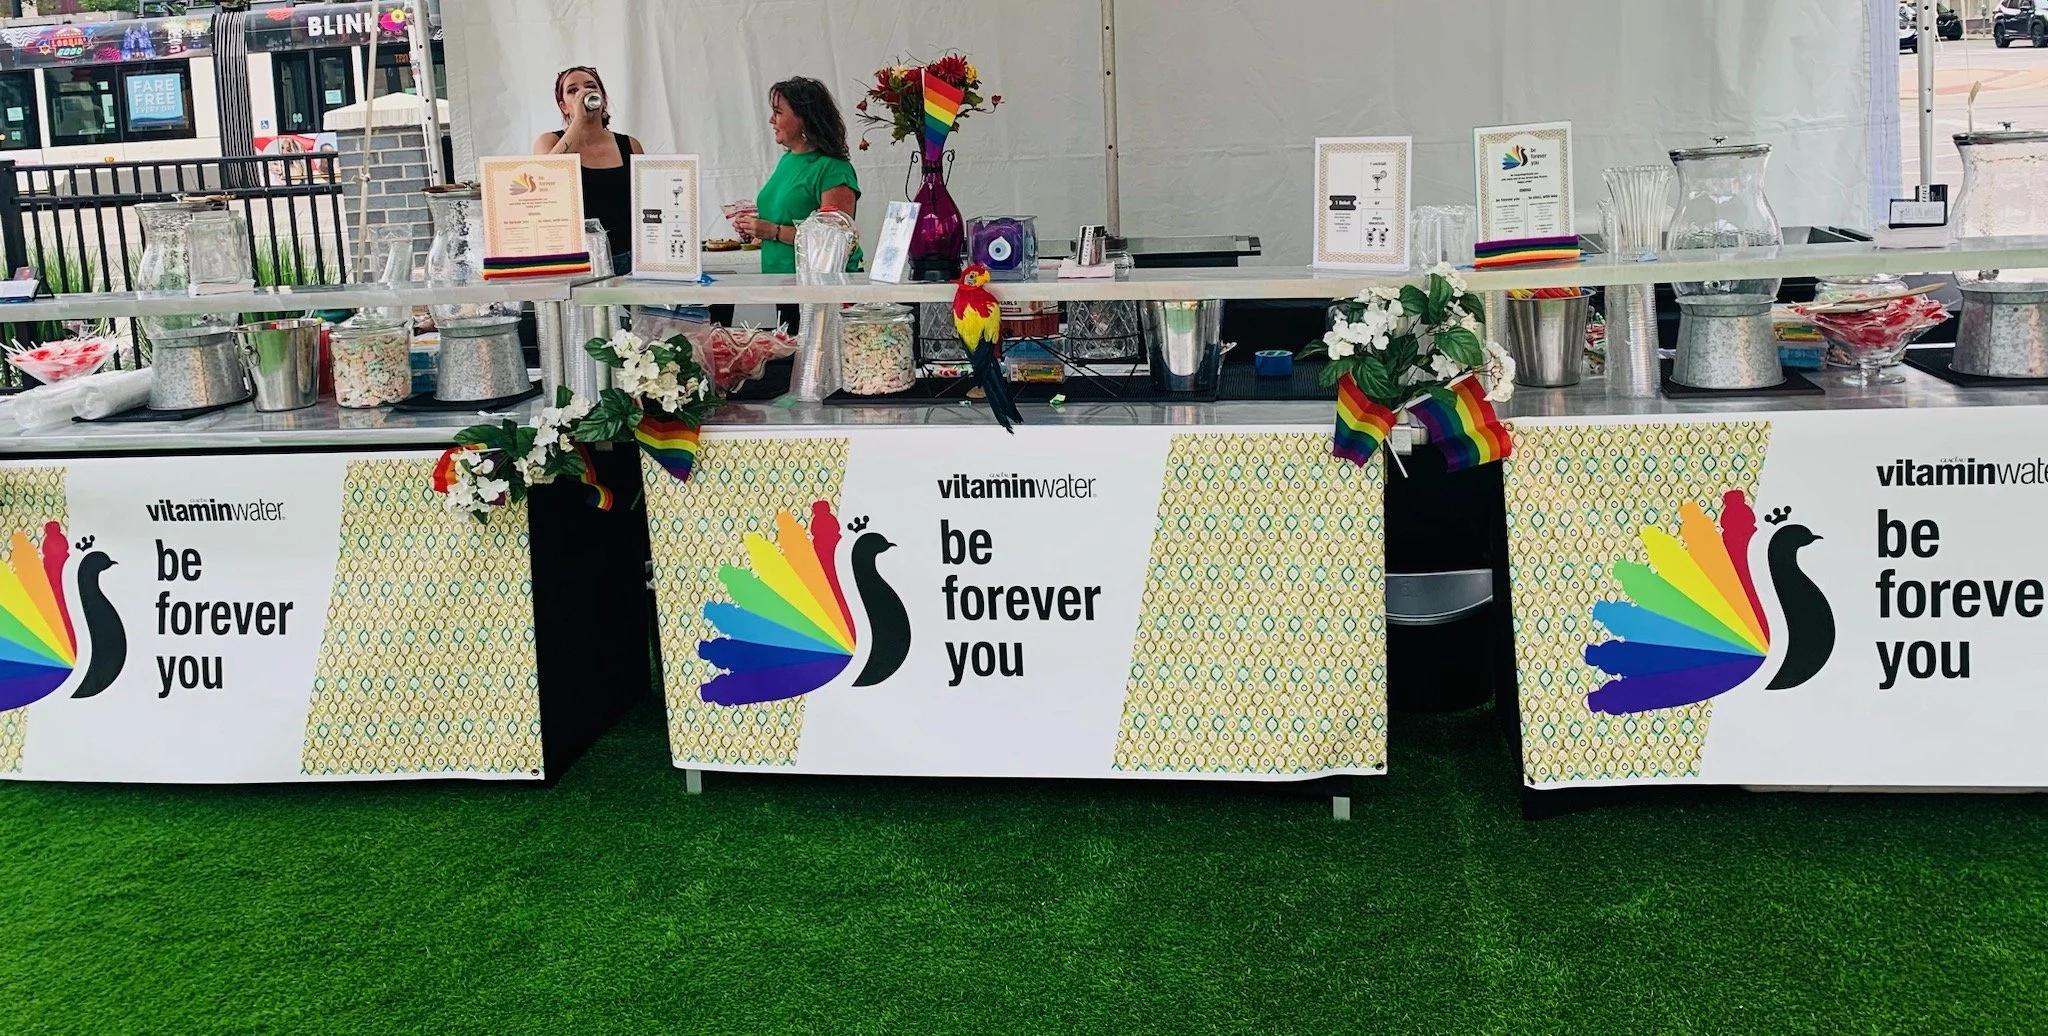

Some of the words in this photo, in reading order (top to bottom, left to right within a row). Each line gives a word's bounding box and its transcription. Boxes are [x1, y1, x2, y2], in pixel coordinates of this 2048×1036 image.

[307, 12, 380, 36] BLINK
[133, 79, 175, 93] FARE
[135, 91, 176, 107] FREE
[937, 473, 1097, 499] vitaminwater
[1876, 458, 2048, 486] vitaminwat
[146, 498, 285, 522] vitaminwater
[940, 519, 993, 565] be
[1877, 508, 1940, 559] be
[155, 538, 202, 582] be
[155, 590, 294, 636] forever
[941, 574, 1102, 621] forever
[156, 655, 223, 699] you
[944, 641, 1024, 687] you
[1875, 640, 1971, 690] you
